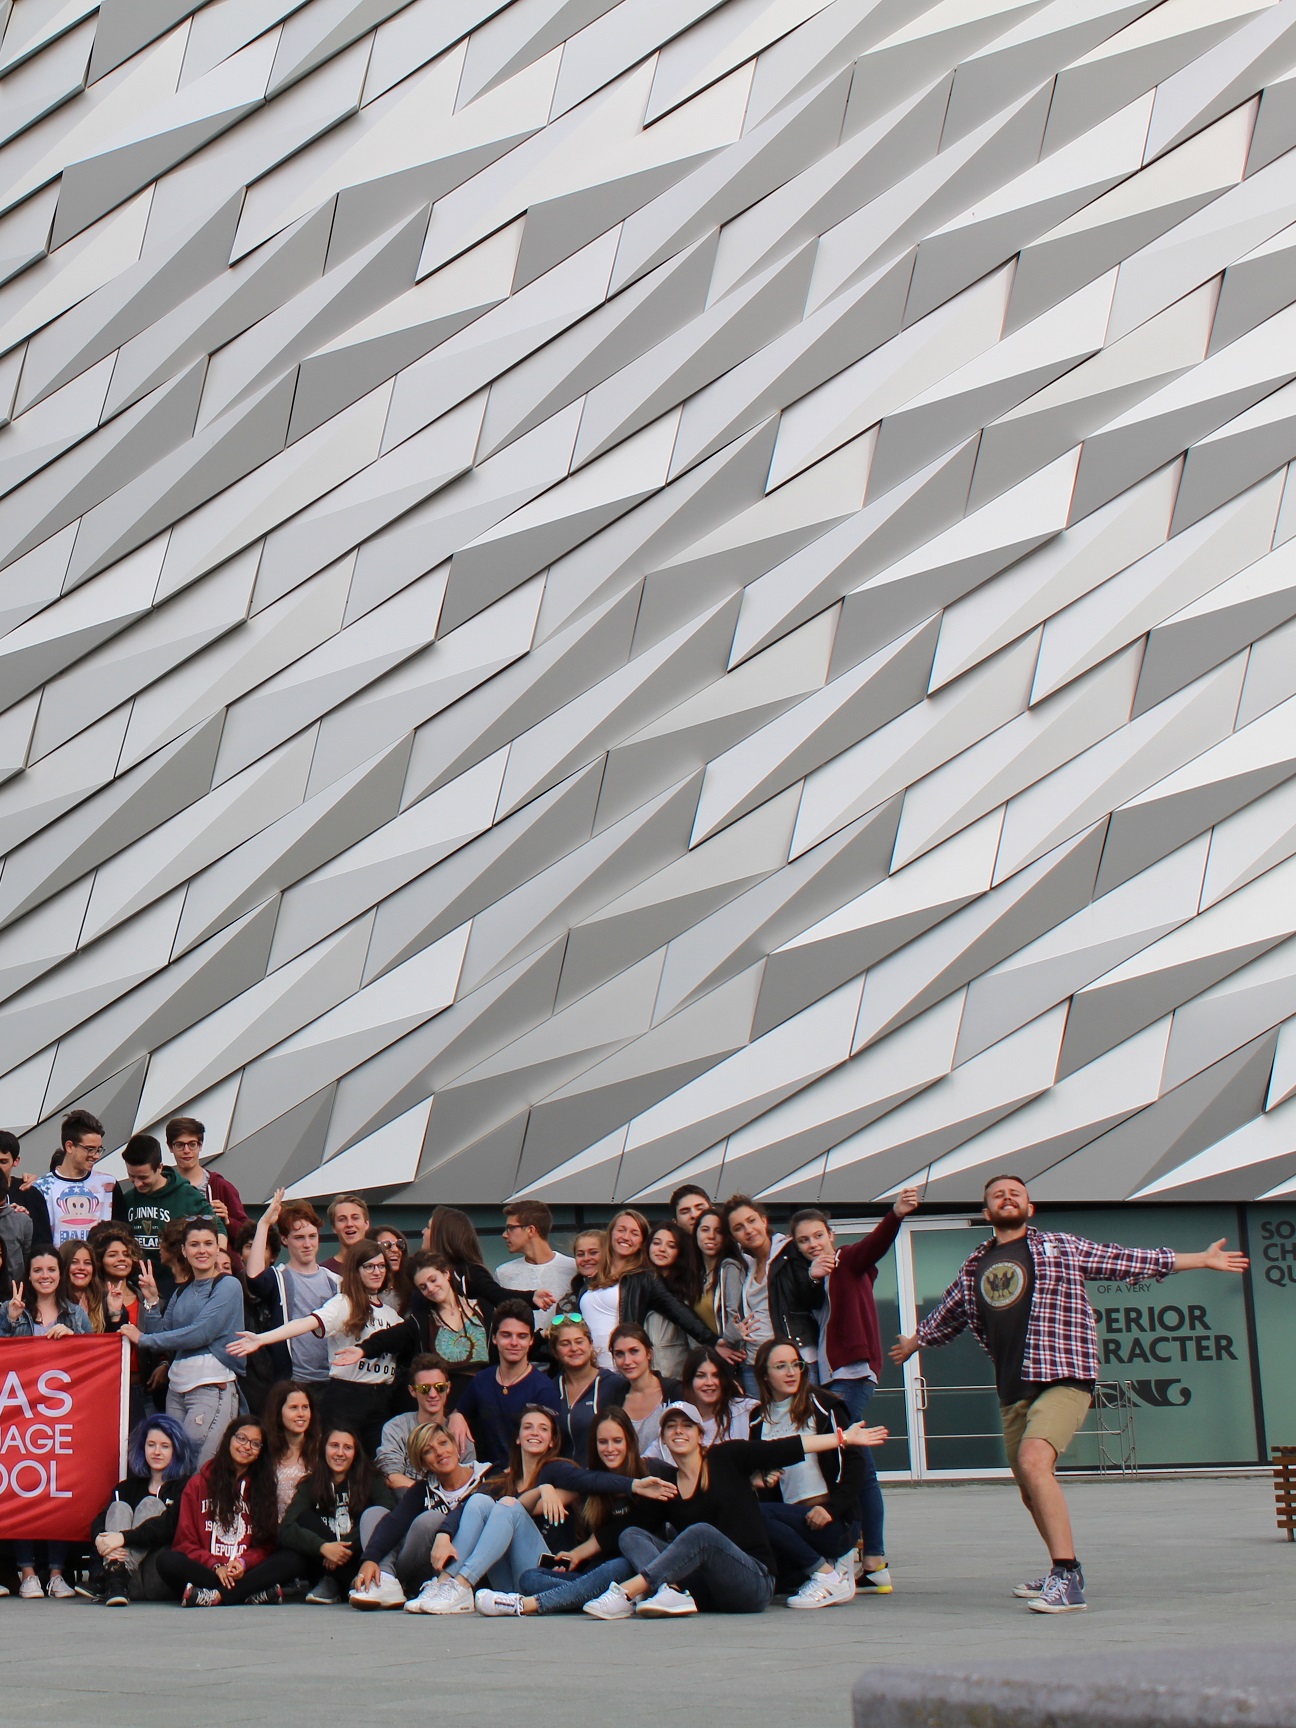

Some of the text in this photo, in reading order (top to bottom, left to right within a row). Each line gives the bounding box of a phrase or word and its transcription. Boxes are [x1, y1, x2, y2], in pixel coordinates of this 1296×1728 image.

[1261, 1220, 1296, 1240] SO
[1263, 1243, 1296, 1262] CH
[1097, 1283, 1152, 1294] OF A VERY
[1098, 1335, 1238, 1364] RACTER
[358, 1361, 395, 1376] BLOOD
